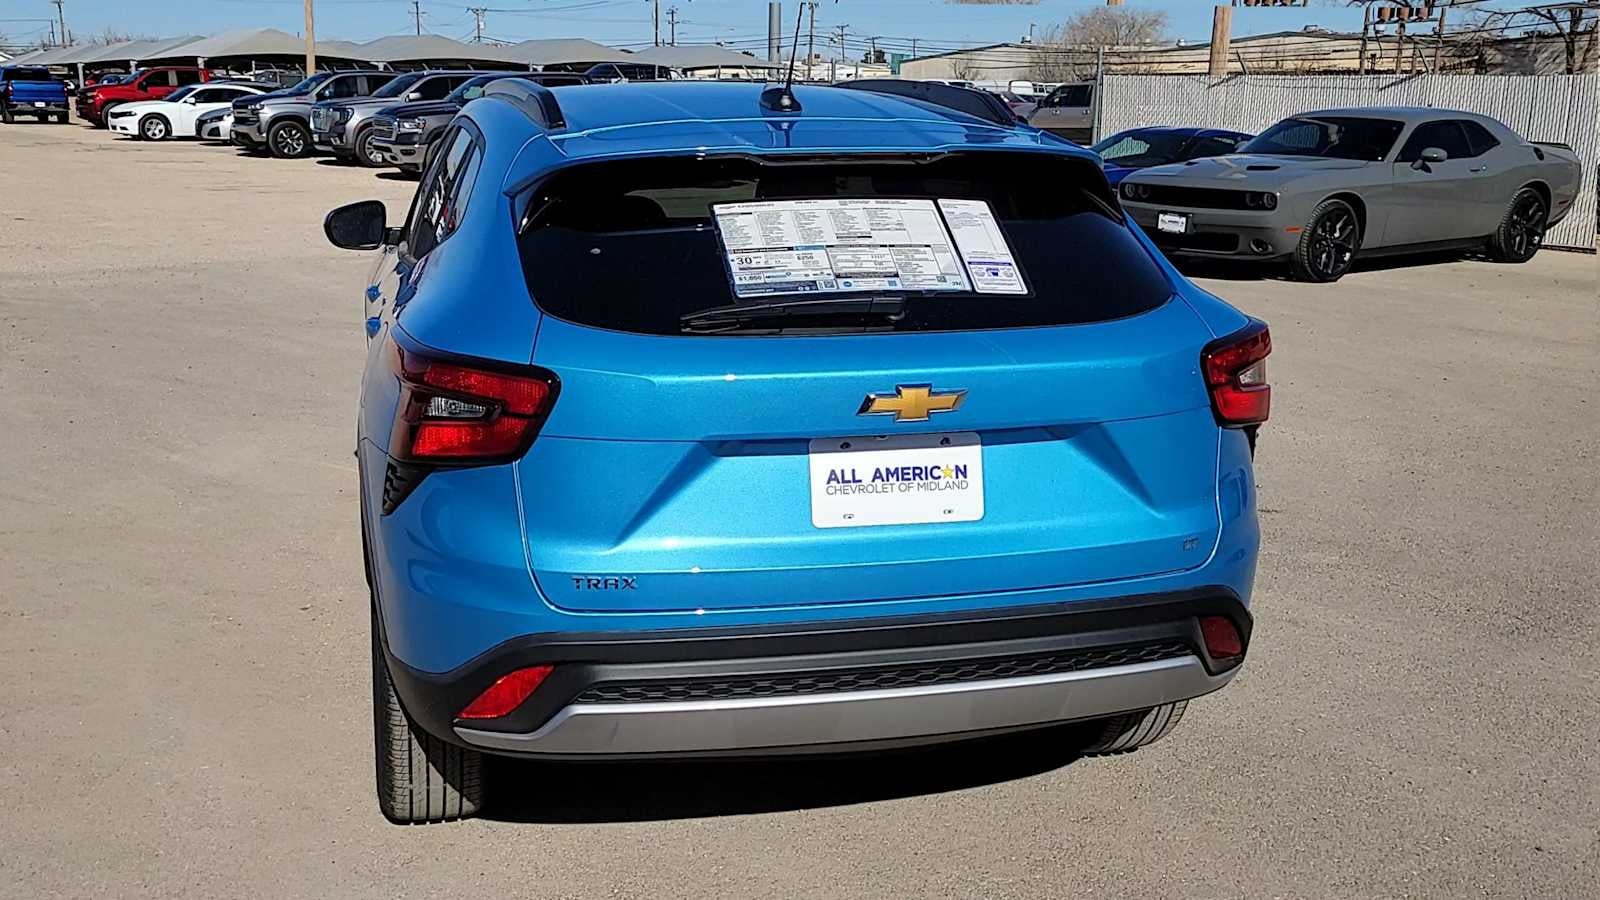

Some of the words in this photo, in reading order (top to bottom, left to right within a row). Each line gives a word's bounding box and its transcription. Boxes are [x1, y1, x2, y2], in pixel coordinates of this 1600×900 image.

[826, 469, 862, 485] ALL
[826, 482, 896, 496] CHEVROLET
[897, 482, 914, 493] OF
[917, 480, 969, 492] MIDLAND
[571, 576, 637, 590] TRAX
